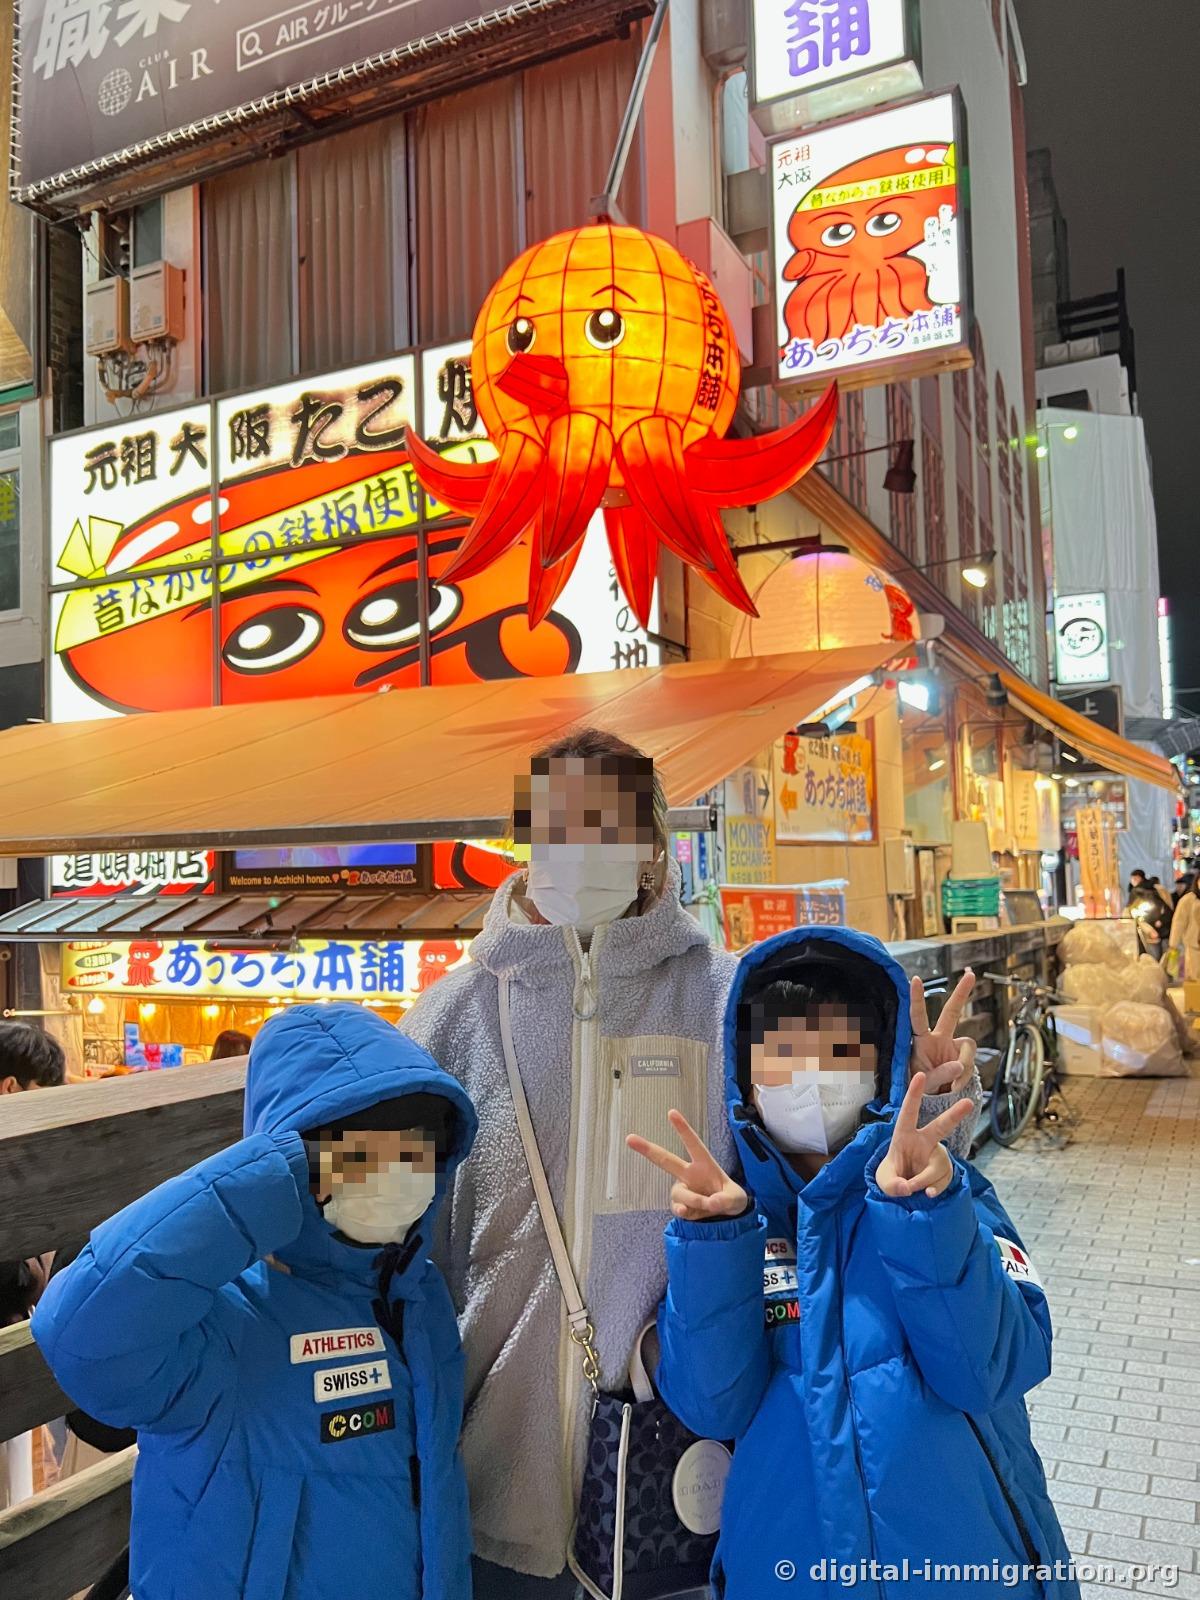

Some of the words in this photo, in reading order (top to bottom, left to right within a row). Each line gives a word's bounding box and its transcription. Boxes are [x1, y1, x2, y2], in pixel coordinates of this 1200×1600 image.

[276, 17, 309, 46] AIR
[135, 48, 214, 103] AIR
[777, 145, 811, 168] 元祖
[777, 166, 812, 191] 大阪
[785, 305, 954, 369] あっちち本舗
[729, 823, 771, 849] MONEY
[730, 850, 772, 867] EXCHANGE
[230, 876, 262, 886] Welcome
[263, 875, 272, 885] to
[273, 874, 305, 885] Acchichi
[302, 1333, 375, 1356] ATHLETICS
